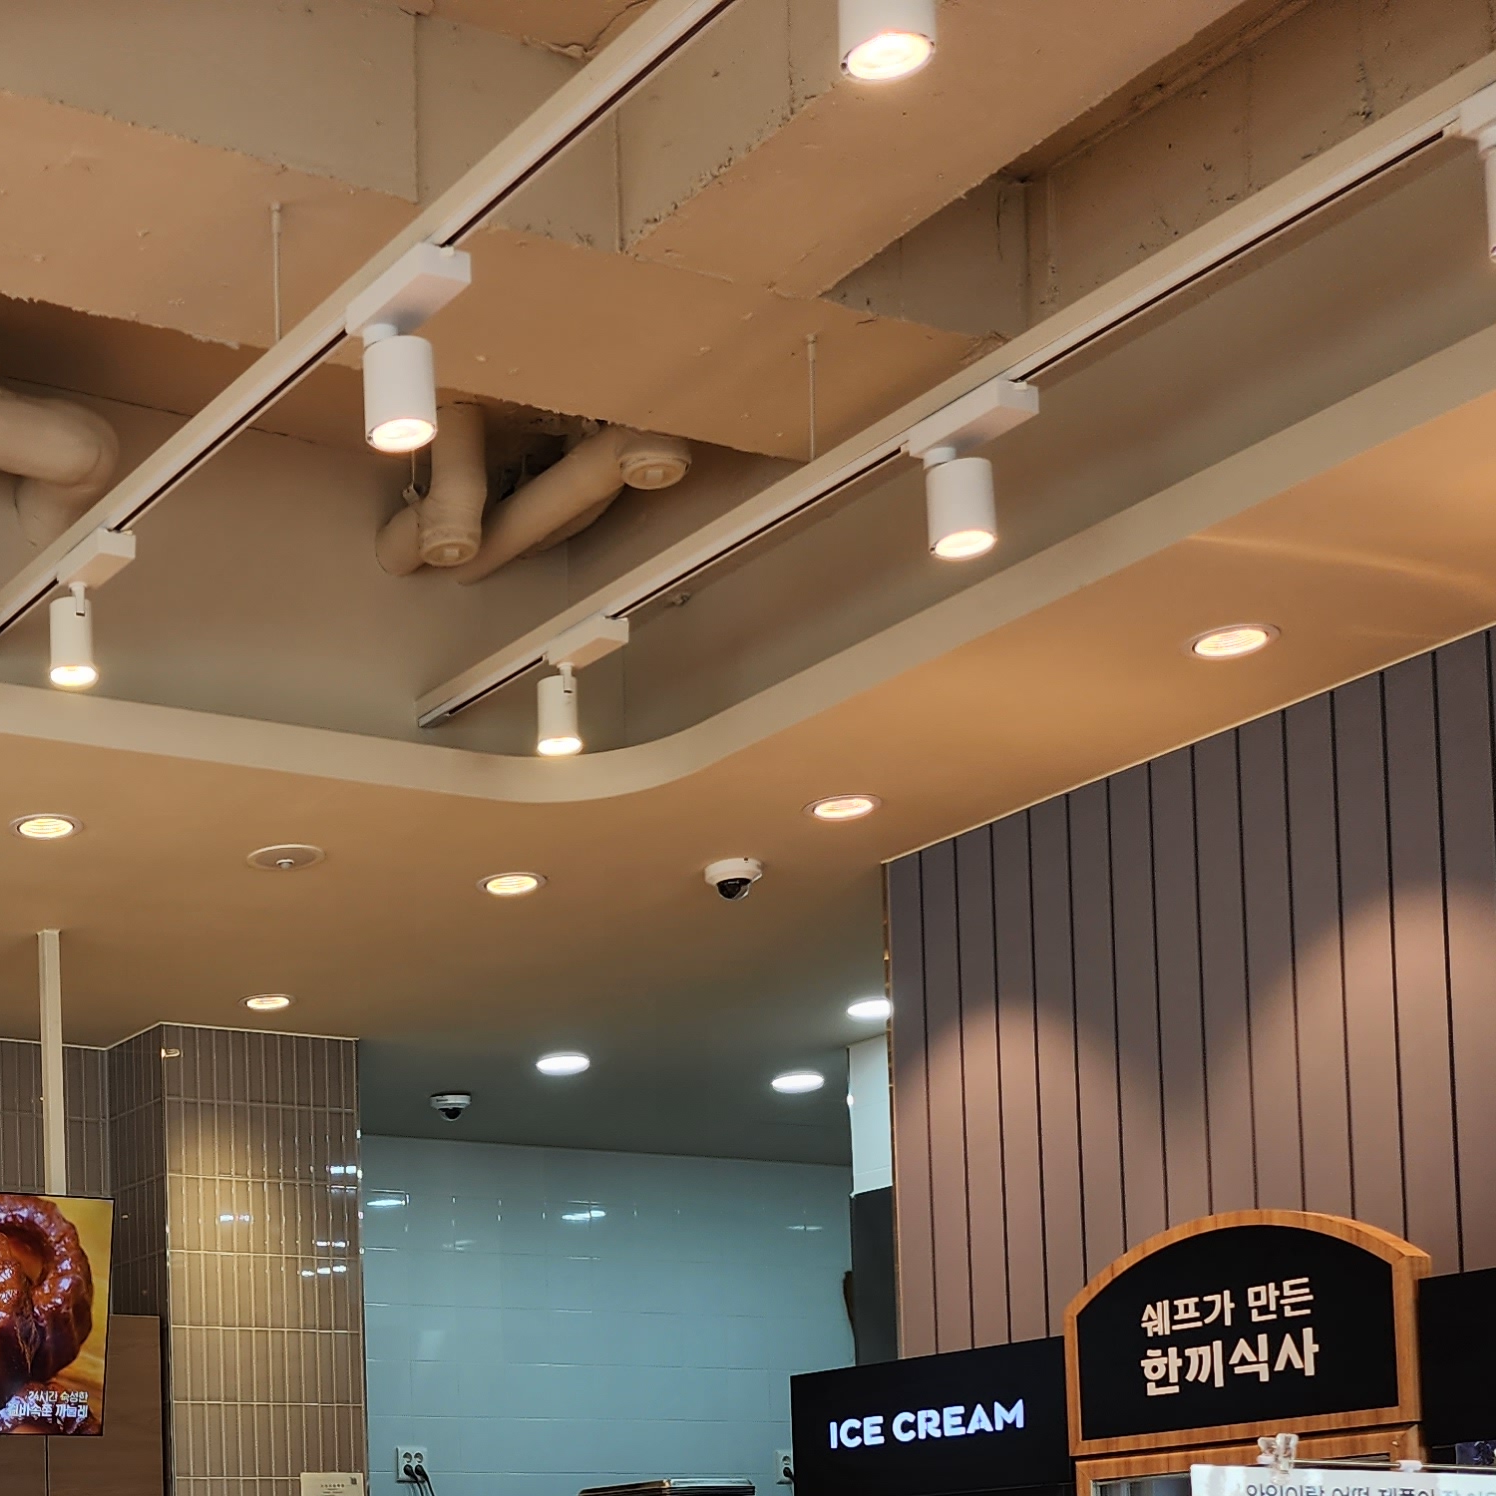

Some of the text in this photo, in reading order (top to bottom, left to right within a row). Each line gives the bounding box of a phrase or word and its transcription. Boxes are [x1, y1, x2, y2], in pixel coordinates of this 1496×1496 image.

[1140, 1276, 1315, 1339] 쉐프가 만든
[1140, 1326, 1320, 1397] 한끼식사
[28, 1390, 58, 1402] 24시간
[829, 1398, 1026, 1449] ICE CREAM
